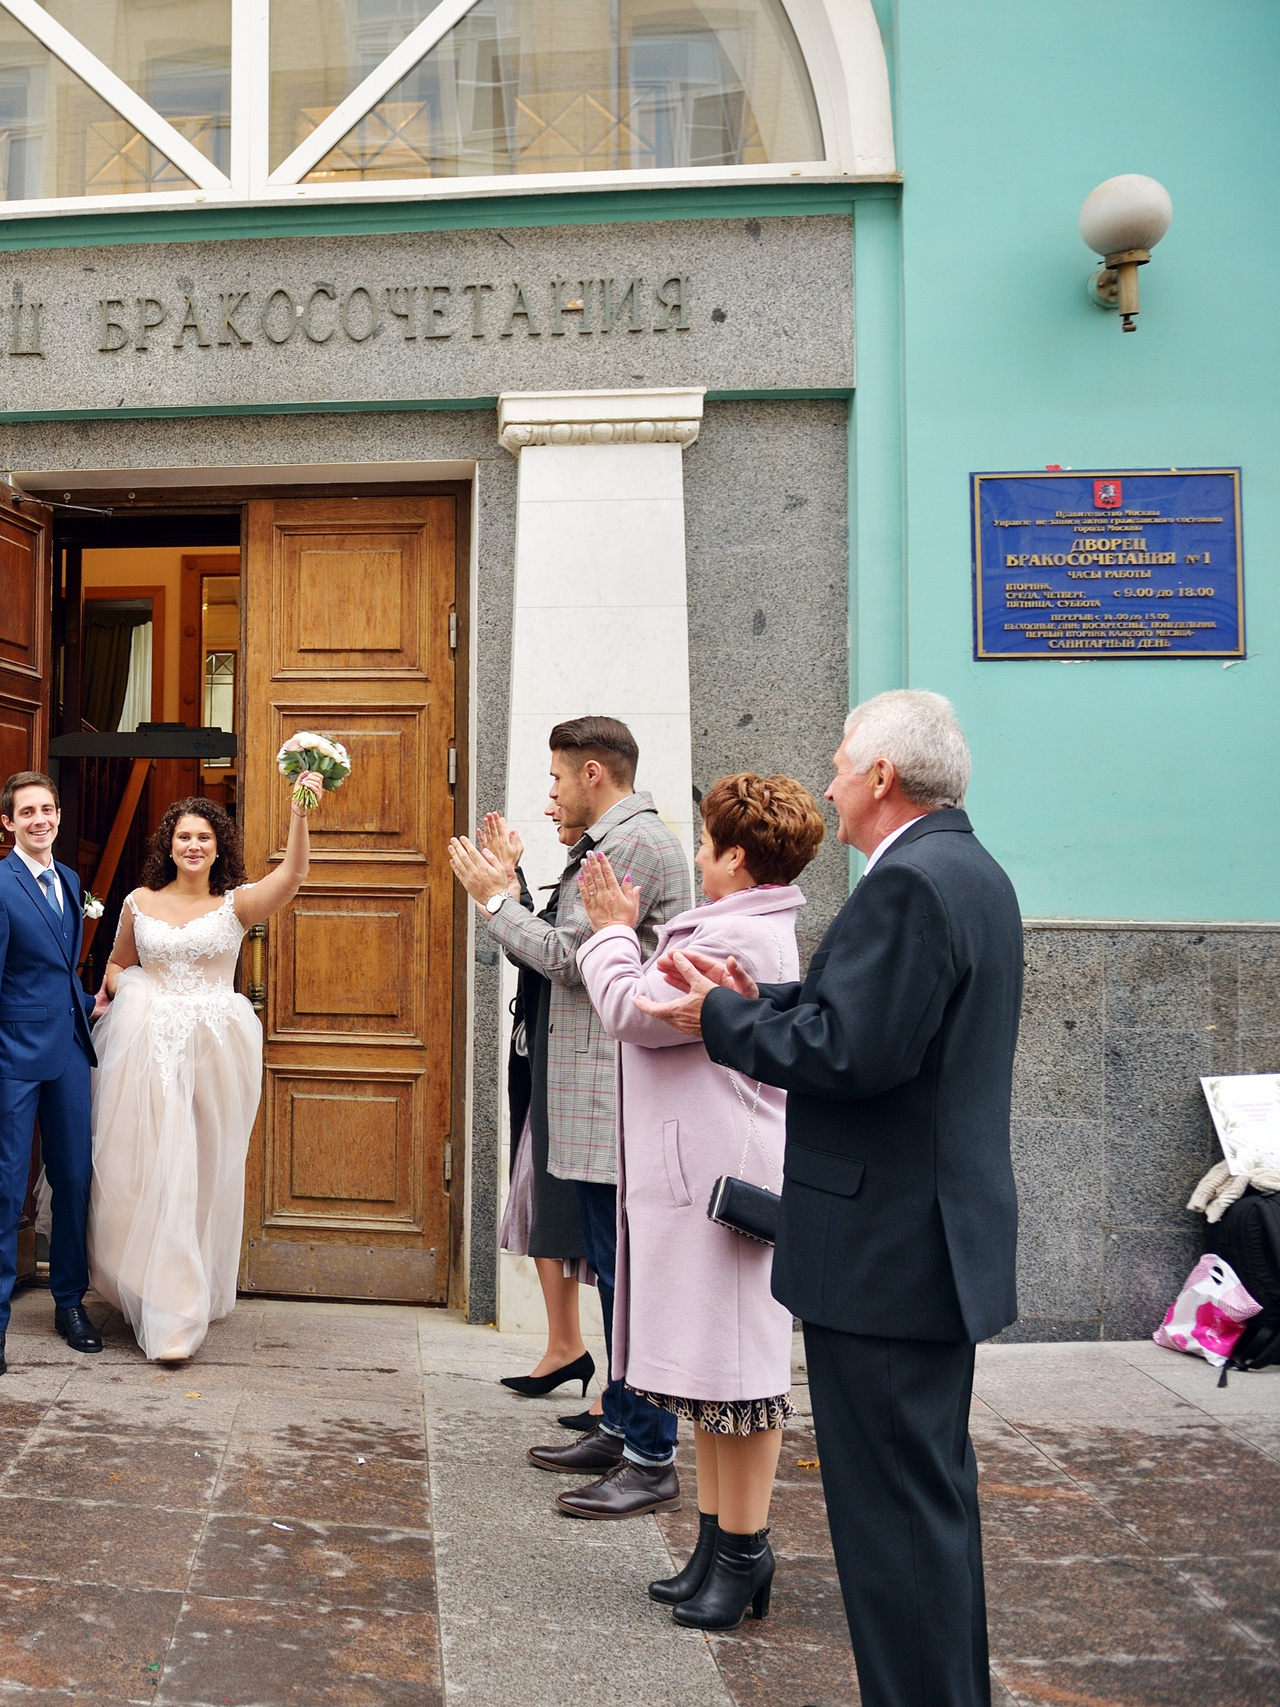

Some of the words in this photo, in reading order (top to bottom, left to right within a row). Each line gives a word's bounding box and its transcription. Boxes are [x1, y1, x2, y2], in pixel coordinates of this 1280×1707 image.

[97, 274, 691, 352] БРАКОСОЧЕТАНИЯ
[1073, 525, 1105, 533] города
[1070, 538, 1147, 553] ДВОРЕЦ
[1005, 552, 1177, 567] БРАКОСОЧЕТАНИЯ
[1067, 571, 1102, 579] ЧАСЫ
[1104, 570, 1152, 579] РАБОТЫ
[1123, 588, 1154, 598] 9.00
[1156, 589, 1174, 598] до
[1177, 587, 1215, 597] 18.00
[1056, 600, 1101, 608] СУББОТА
[1003, 623, 1056, 631] ВЫХОДНЫЕ
[1150, 621, 1217, 629] ПОНЕДЕЛЬНИК
[1025, 630, 1064, 638] ПЕРВЫЙ
[1108, 630, 1153, 638] КАЖДОГО
[1048, 638, 1135, 649] САНИТАРНЫЙ
[1137, 638, 1172, 649] ДЕНЬ
